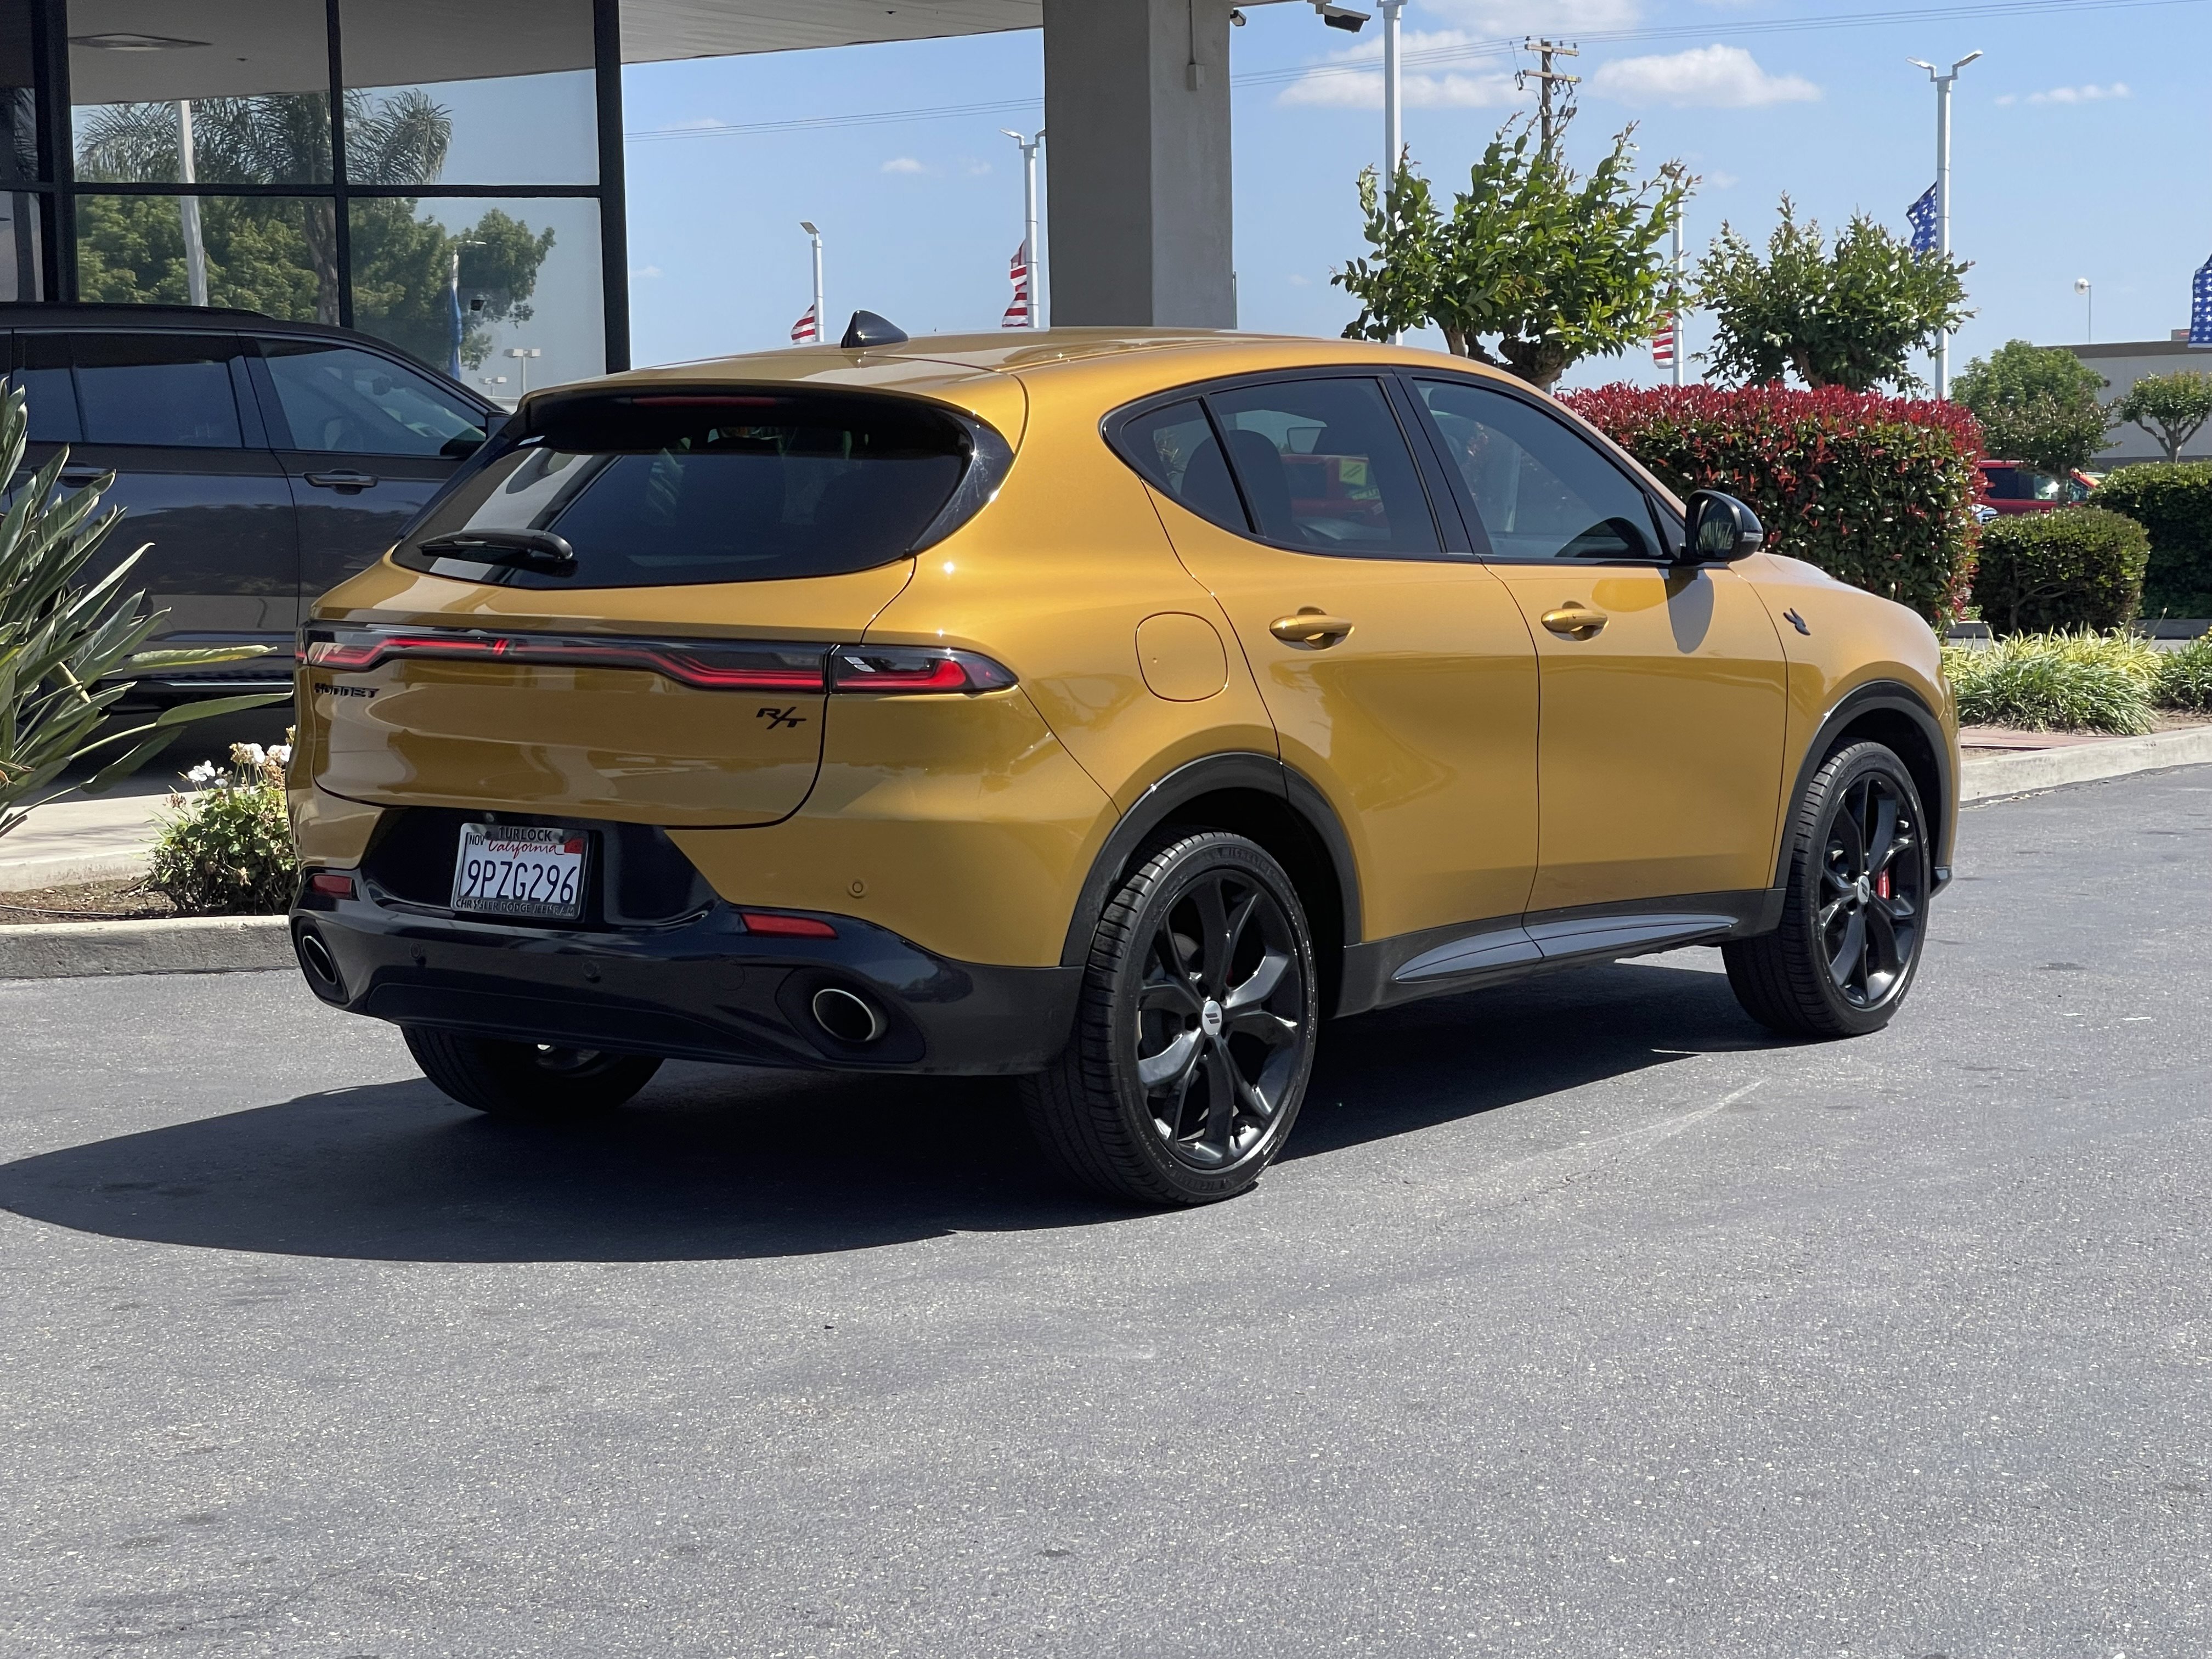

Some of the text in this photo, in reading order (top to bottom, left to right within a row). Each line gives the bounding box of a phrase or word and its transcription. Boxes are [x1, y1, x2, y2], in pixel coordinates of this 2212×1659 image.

[756, 706, 807, 730] R/T
[469, 834, 484, 846] NOV
[499, 827, 552, 842] TURLOCK
[488, 839, 565, 859] California
[464, 859, 577, 904] 9PZG296
[455, 898, 575, 917] CHRYSLER DODGE JEEP RAM
